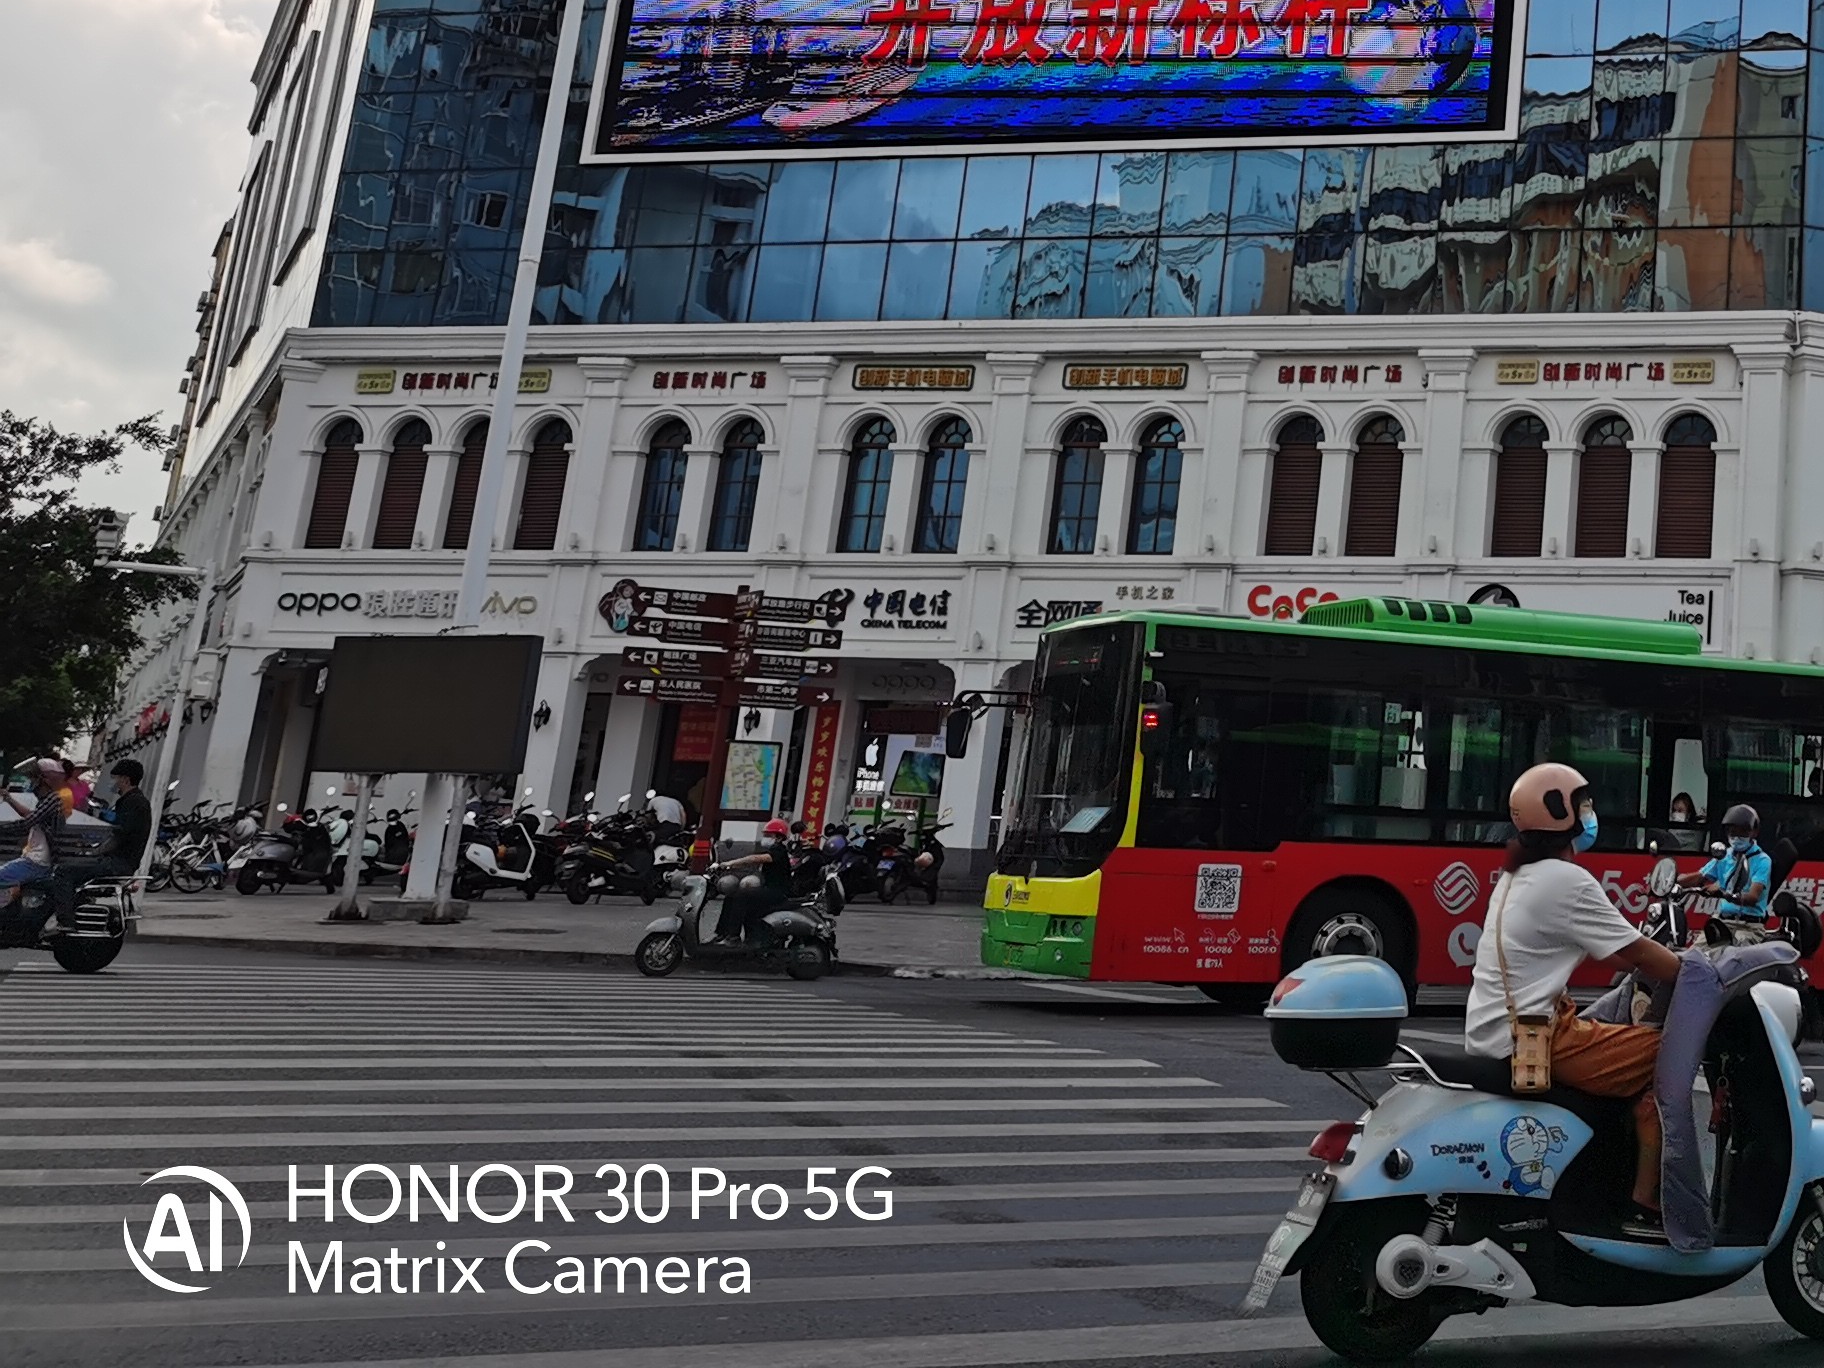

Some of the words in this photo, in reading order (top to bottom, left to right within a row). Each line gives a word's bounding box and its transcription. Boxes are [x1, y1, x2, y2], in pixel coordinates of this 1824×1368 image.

[653, 370, 766, 390] 创新时尚广场
[1278, 364, 1402, 385] 创新时尚广场
[1543, 362, 1665, 383] 创新时尚广场
[1116, 585, 1175, 601] 手机之家
[1677, 589, 1705, 605] Tea
[861, 589, 952, 617] 中国电信
[860, 618, 896, 630] CHINA
[897, 618, 947, 631] TELECOM
[1663, 609, 1704, 625] Juice
[1430, 1143, 1485, 1157] DORAEMON
